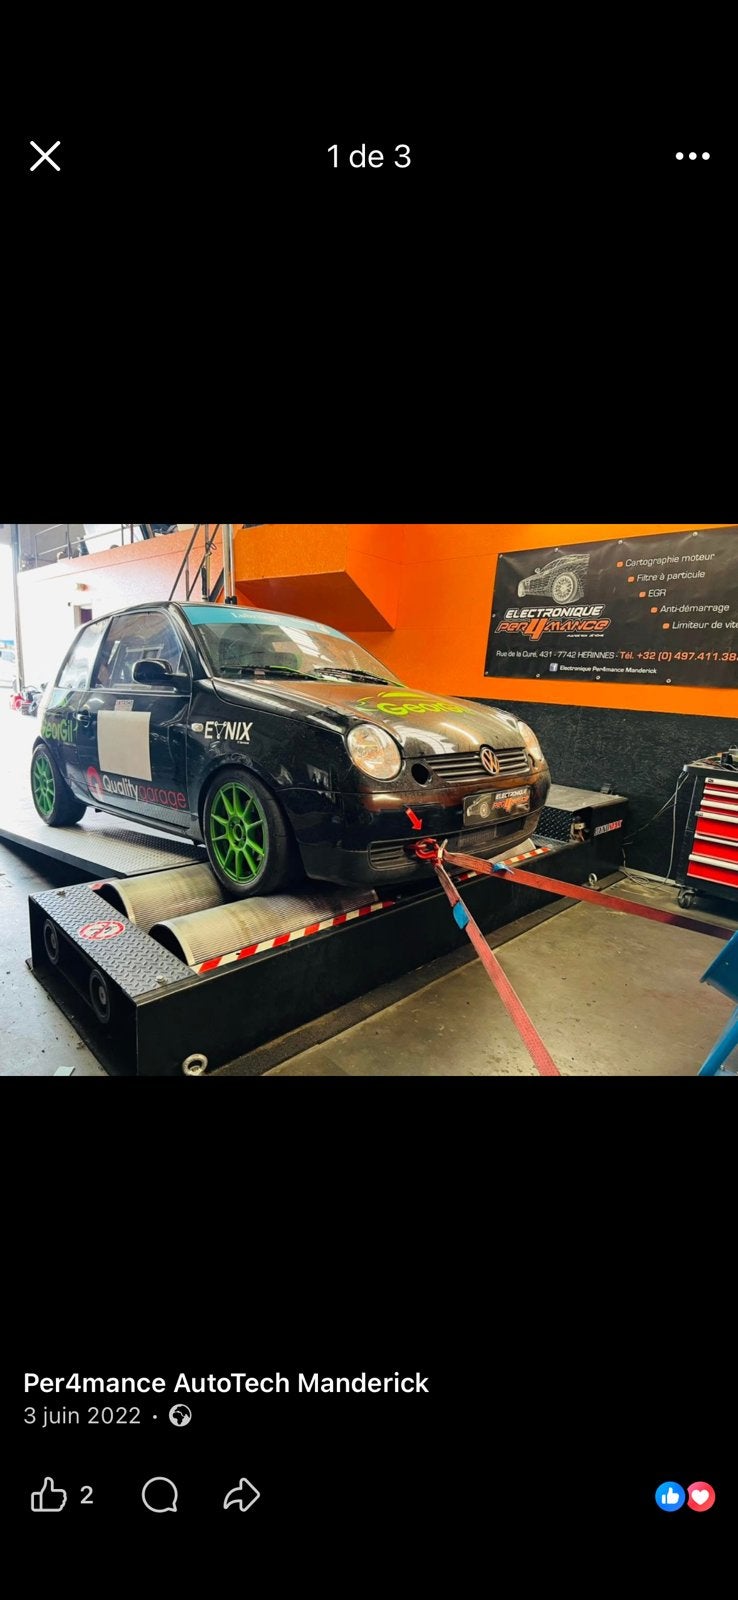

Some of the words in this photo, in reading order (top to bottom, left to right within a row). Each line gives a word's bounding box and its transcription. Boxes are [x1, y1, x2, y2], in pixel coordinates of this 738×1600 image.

[625, 556, 680, 567] Cartographie
[682, 553, 716, 562] moteur
[637, 574, 658, 582] Filtre
[659, 573, 665, 581] à
[667, 570, 706, 582] particule
[648, 589, 667, 598] EGR
[505, 605, 604, 619] ELECTRONIQUE
[660, 604, 730, 614] Anti-démarrage
[672, 621, 710, 630] Limiteur
[711, 621, 723, 629] de
[496, 650, 508, 658] Rue
[508, 650, 516, 658] de
[516, 650, 521, 658] la
[558, 651, 577, 659] 7742
[578, 651, 615, 660] HERINNES
[637, 651, 656, 660] +32
[658, 651, 672, 662] (0)
[560, 665, 592, 673] Electronique
